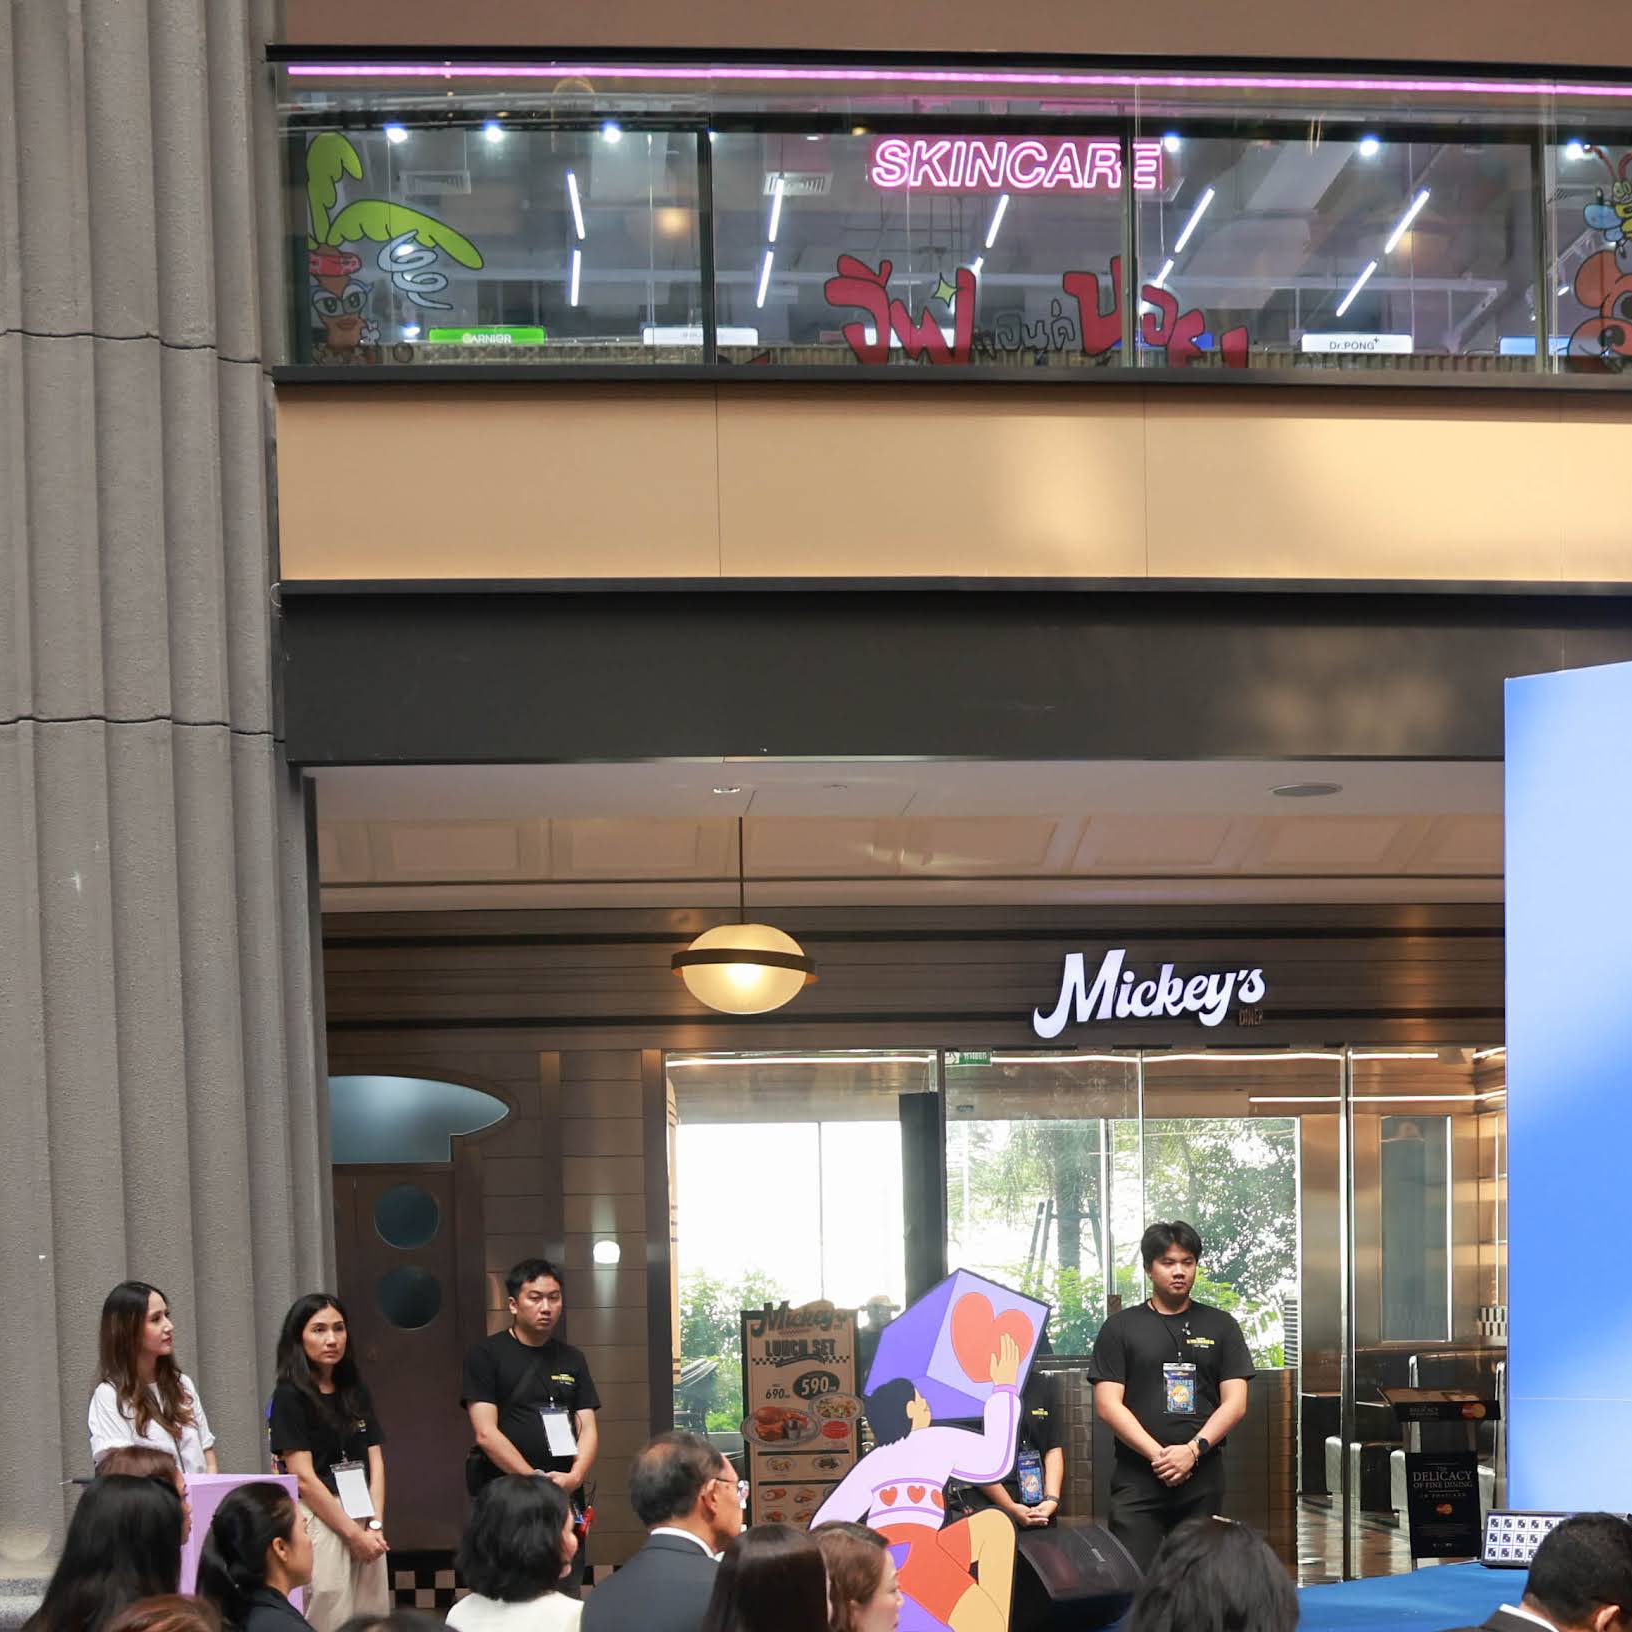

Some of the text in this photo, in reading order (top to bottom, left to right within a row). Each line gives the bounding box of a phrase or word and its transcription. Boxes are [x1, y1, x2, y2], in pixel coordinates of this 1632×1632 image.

[871, 139, 1163, 190] SKINCARE
[462, 332, 512, 344] GARNIER
[1033, 948, 1266, 1039] Mickey's
[1238, 1007, 1264, 1026] DINER
[765, 1388, 785, 1399] 690
[801, 1376, 829, 1396] 590
[1413, 1471, 1473, 1482] DELICACY
